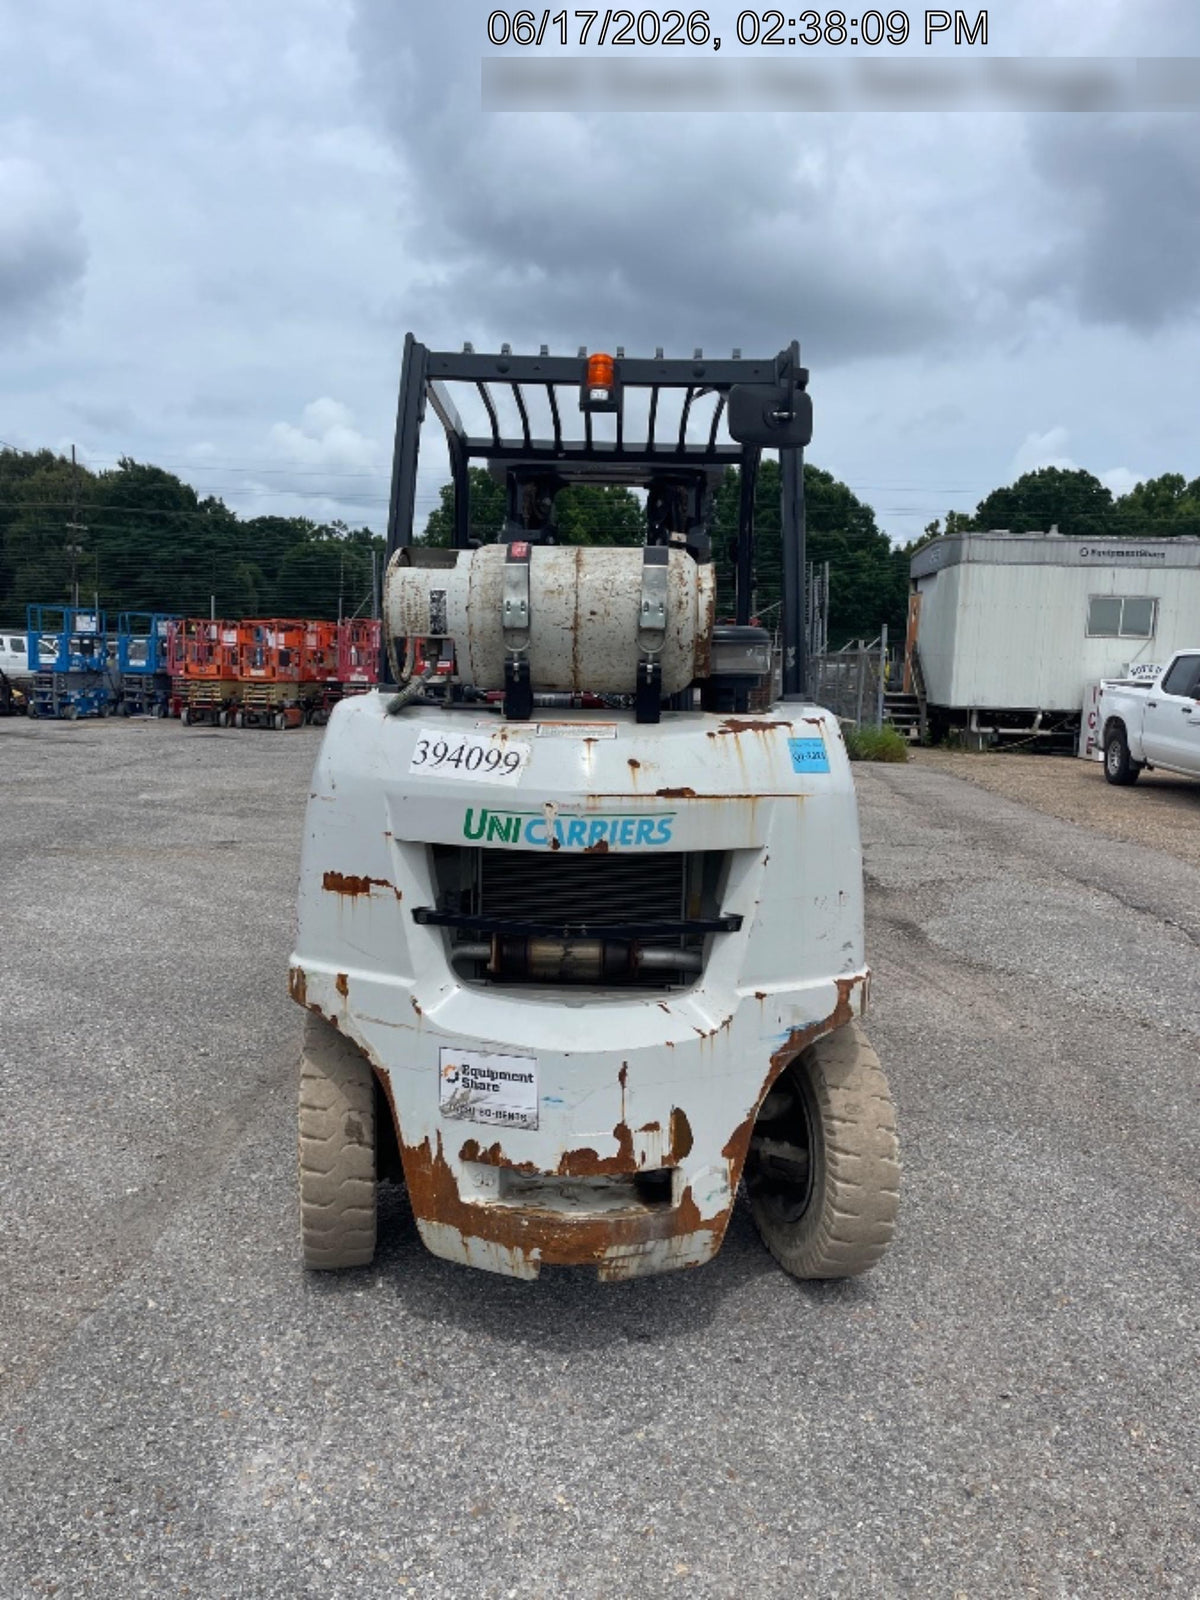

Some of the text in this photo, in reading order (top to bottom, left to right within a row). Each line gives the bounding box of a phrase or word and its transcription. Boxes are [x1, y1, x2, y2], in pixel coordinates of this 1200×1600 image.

[412, 740, 520, 776] 394099
[461, 1064, 535, 1084] Equipment
[461, 1077, 501, 1093] Share
